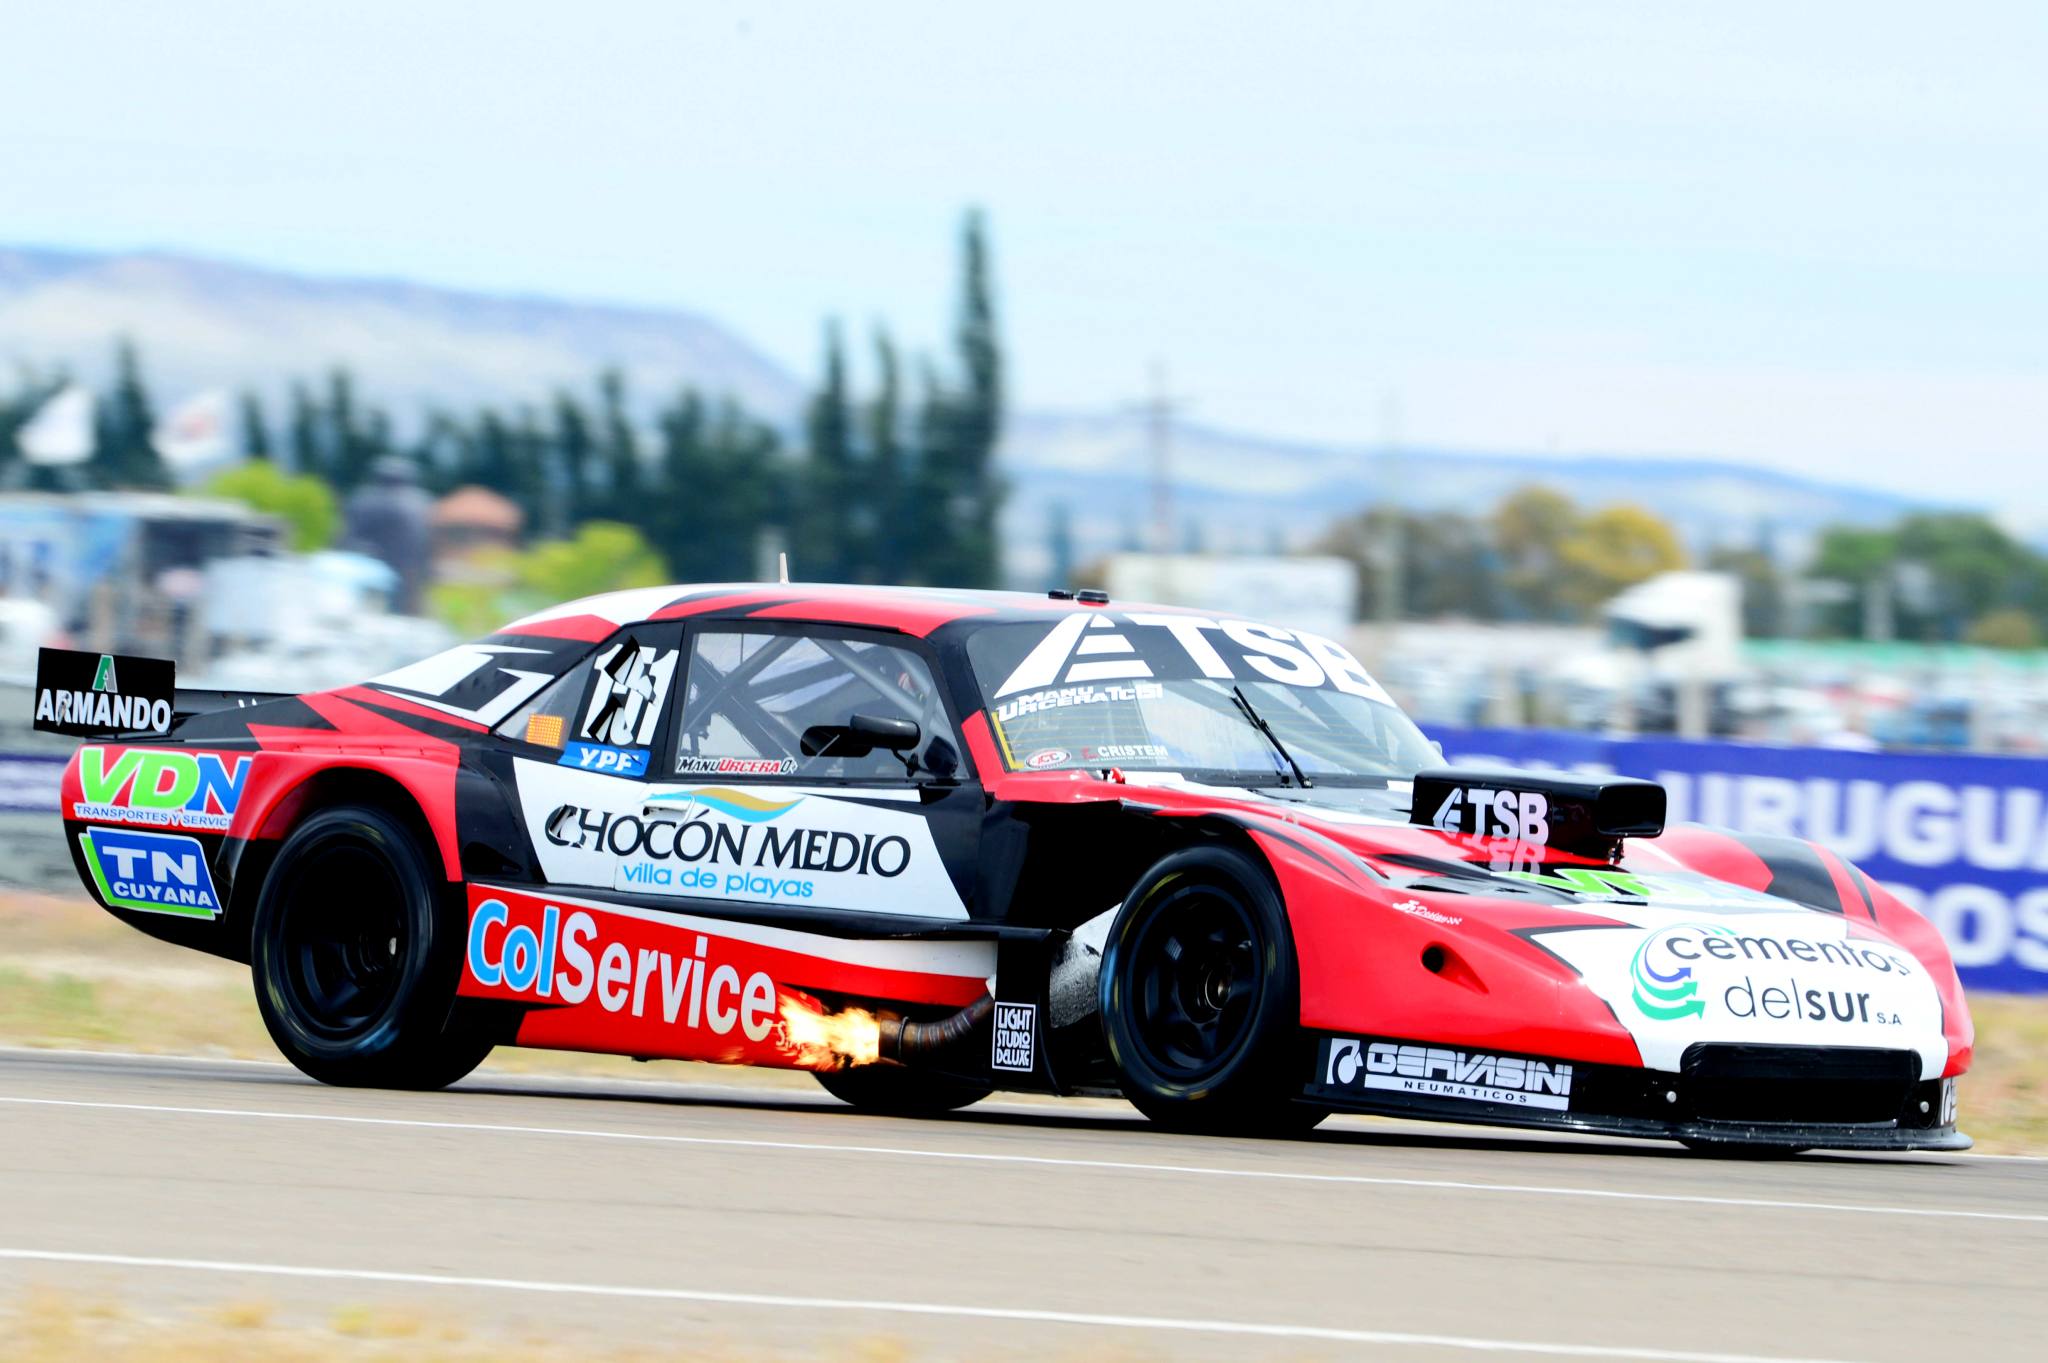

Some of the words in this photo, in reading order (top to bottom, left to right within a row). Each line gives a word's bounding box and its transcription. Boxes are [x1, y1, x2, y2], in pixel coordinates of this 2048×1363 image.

[36, 688, 171, 733] ARMANDO
[579, 747, 640, 771] YPF
[1097, 744, 1169, 758] CRISTEM
[79, 748, 253, 815] VDN
[75, 804, 168, 823] TRANSPORTES
[171, 814, 180, 825] Y
[1656, 768, 2048, 875] URUGU
[545, 803, 752, 866] CHOCÓN
[753, 826, 911, 878] MEDIO
[102, 845, 198, 886] TN
[623, 863, 672, 886] villa
[681, 867, 718, 890] de
[725, 871, 814, 898] playas
[113, 881, 213, 907] CUYANA
[467, 899, 777, 1042] ColService
[1665, 934, 1912, 977] cementos
[998, 1007, 1032, 1031] LIGHT
[997, 1029, 1031, 1050] STUDIO
[1366, 1042, 1573, 1096] GERVASINI
[1404, 1080, 1528, 1104] NEUMATICOS
